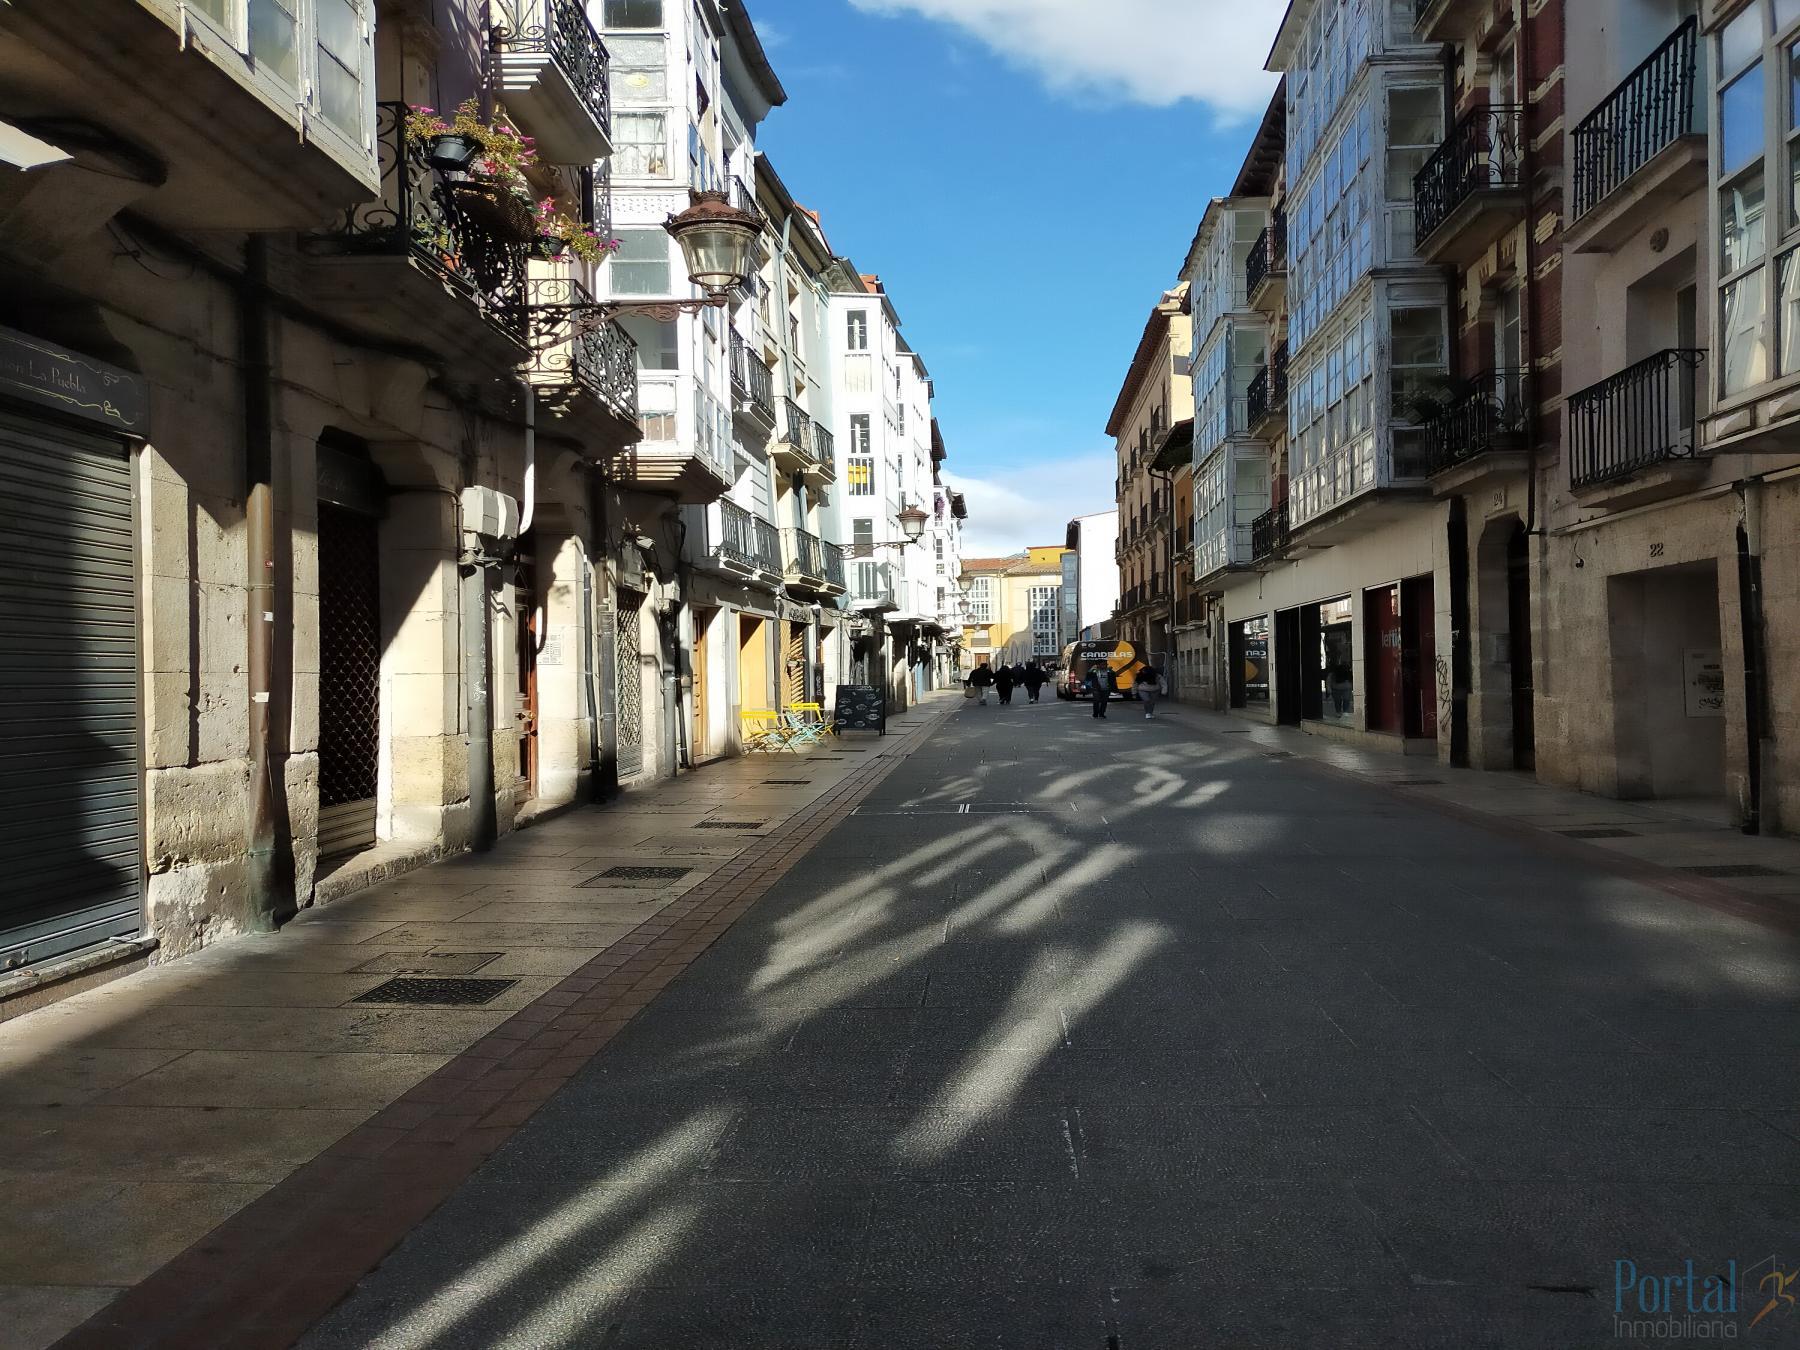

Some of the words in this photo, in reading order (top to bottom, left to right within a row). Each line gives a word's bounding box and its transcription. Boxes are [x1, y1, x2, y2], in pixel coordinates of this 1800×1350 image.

[52, 367, 88, 394] Puebla
[1650, 542, 1664, 557] 22
[1080, 651, 1133, 659] CANDELAS
